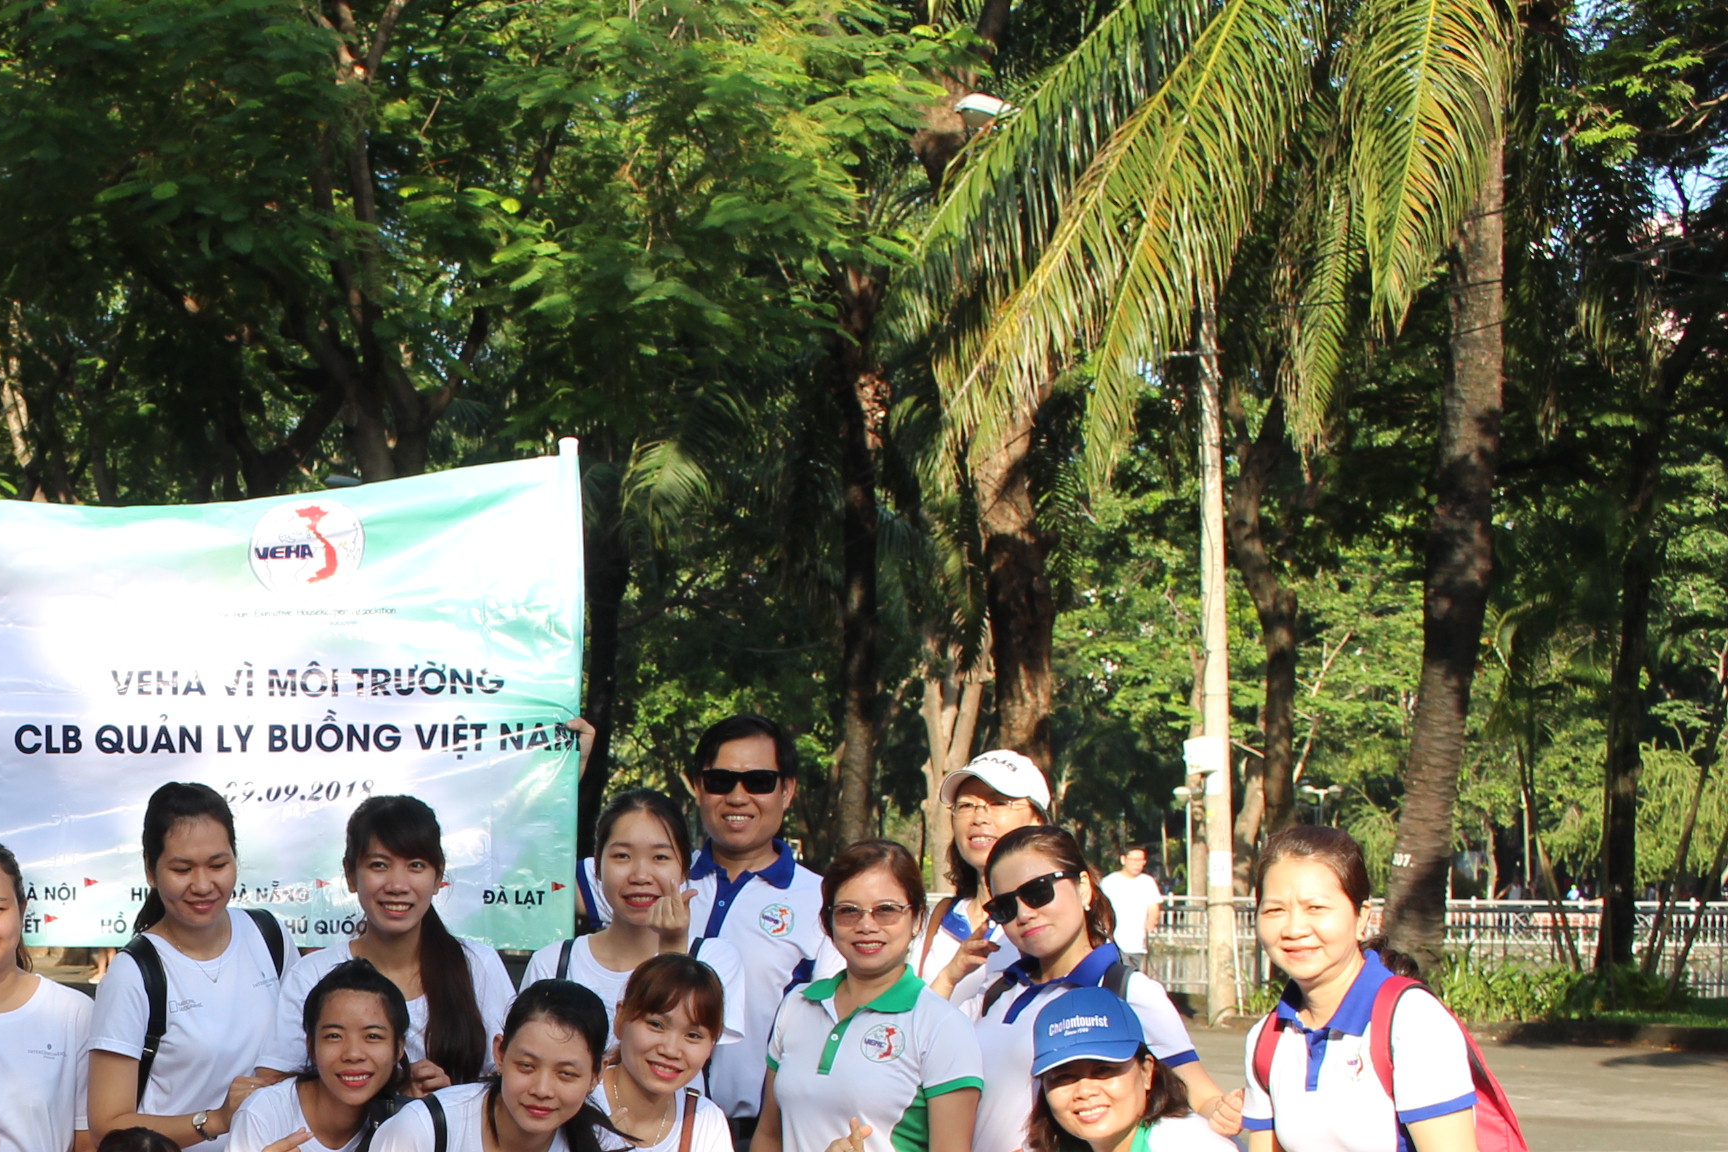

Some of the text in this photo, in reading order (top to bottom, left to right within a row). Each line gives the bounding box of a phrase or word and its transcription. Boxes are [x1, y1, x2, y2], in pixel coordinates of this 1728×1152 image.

[255, 544, 314, 560] VEHA
[111, 669, 207, 696] VEHA
[268, 660, 339, 698] MÔI
[351, 660, 505, 698] TRƯỜNG
[14, 723, 83, 754] CLB
[95, 713, 203, 754] QUẢN
[268, 708, 402, 754] BUỒNG
[415, 714, 488, 760] VIỆT
[499, 722, 580, 752] NAM
[44, 882, 76, 906] NỘI
[483, 885, 545, 910] ĐÀ LẠT
[1048, 1014, 1109, 1036] Cholontourist
